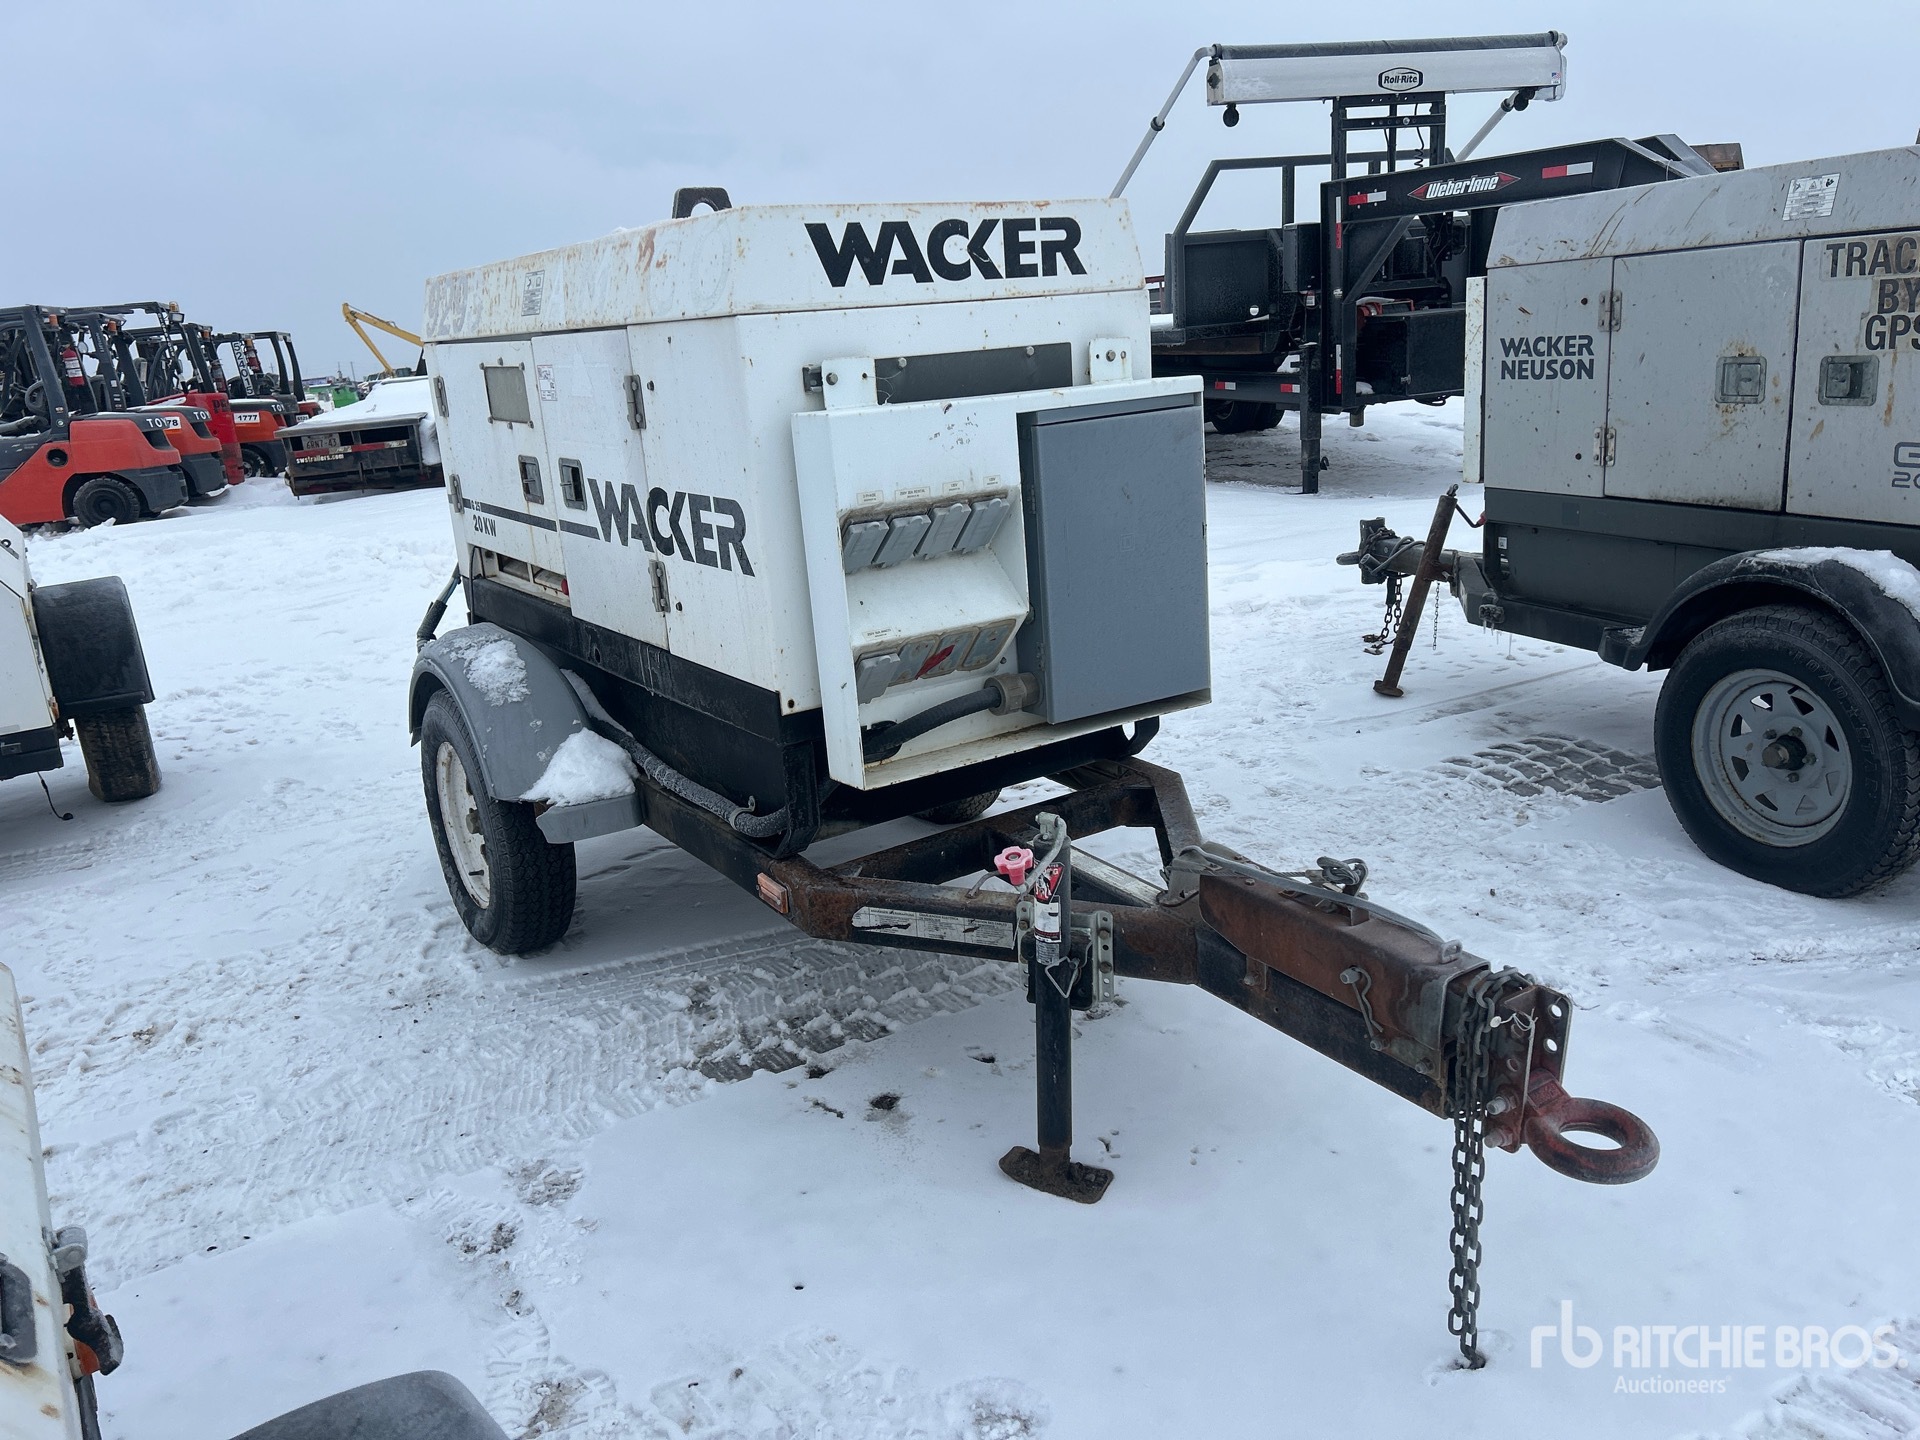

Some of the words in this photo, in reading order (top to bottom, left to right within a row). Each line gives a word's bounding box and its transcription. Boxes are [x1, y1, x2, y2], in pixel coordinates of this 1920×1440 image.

[1383, 74, 1418, 84] Roll-Rite
[1426, 176, 1499, 199] Weberlane
[804, 217, 1087, 287] WACKER
[1826, 237, 1920, 278] TRAC
[1500, 335, 1594, 357] WACKER
[1501, 359, 1595, 380] NEUSON
[587, 478, 756, 578] WACKER
